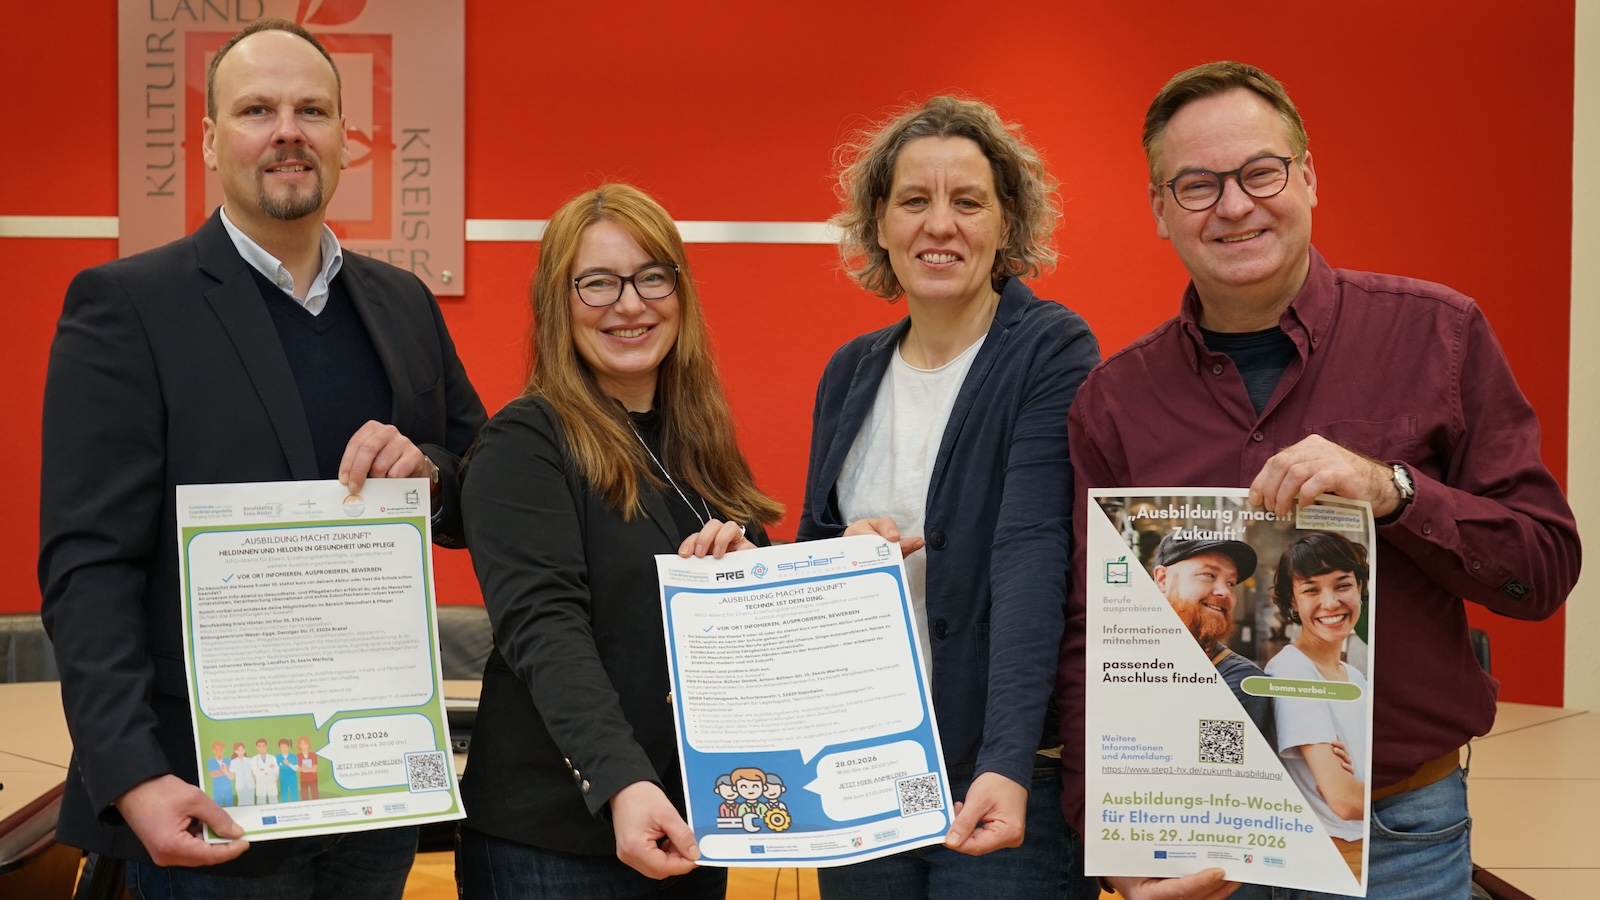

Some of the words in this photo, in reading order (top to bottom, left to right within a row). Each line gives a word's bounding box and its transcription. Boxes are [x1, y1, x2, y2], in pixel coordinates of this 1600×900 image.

[151, 0, 264, 22] LAND
[146, 28, 176, 196] KULTUR
[402, 128, 430, 241] KREIS
[1238, 510, 1292, 522] mact
[1300, 514, 1360, 523] Koordinierungsstelle
[300, 534, 330, 542] MACHT
[778, 556, 845, 571] spier
[716, 570, 745, 581] PRG
[775, 588, 804, 598] MACHT
[745, 602, 775, 610] TECHNIK
[1103, 605, 1162, 614] ausprobieren
[828, 610, 860, 618] BEWERBEN
[1103, 624, 1182, 634] Informationen
[1103, 636, 1160, 645] mitnehmen
[1103, 658, 1174, 672] passenden
[1102, 672, 1168, 683] Anschluss
[1172, 672, 1217, 684] finden!
[1269, 683, 1296, 692] komm
[1298, 686, 1326, 694] vorbei
[342, 731, 389, 741] 27.01.2026
[370, 759, 403, 767] ANMELDEN
[835, 756, 877, 768] 28.01.2026
[1121, 753, 1173, 762] Anmeldung:
[1102, 766, 1283, 781] https://www.step1-hx.de/zukunft-ausbildung/
[839, 781, 856, 789] JETZT
[857, 778, 872, 786] HIER
[874, 771, 908, 783] ANMELDEN
[1102, 792, 1303, 813] Ausbildungs-Info-Woche
[1102, 809, 1124, 822] für
[1130, 810, 1175, 823] Eltern
[1180, 810, 1210, 824] und
[1215, 812, 1314, 833] Jugendliche
[1102, 828, 1124, 840] 26.
[1130, 828, 1154, 841] bis
[1159, 830, 1182, 842] 29.
[1187, 830, 1243, 844] Januar
[1248, 833, 1286, 848] 2026
